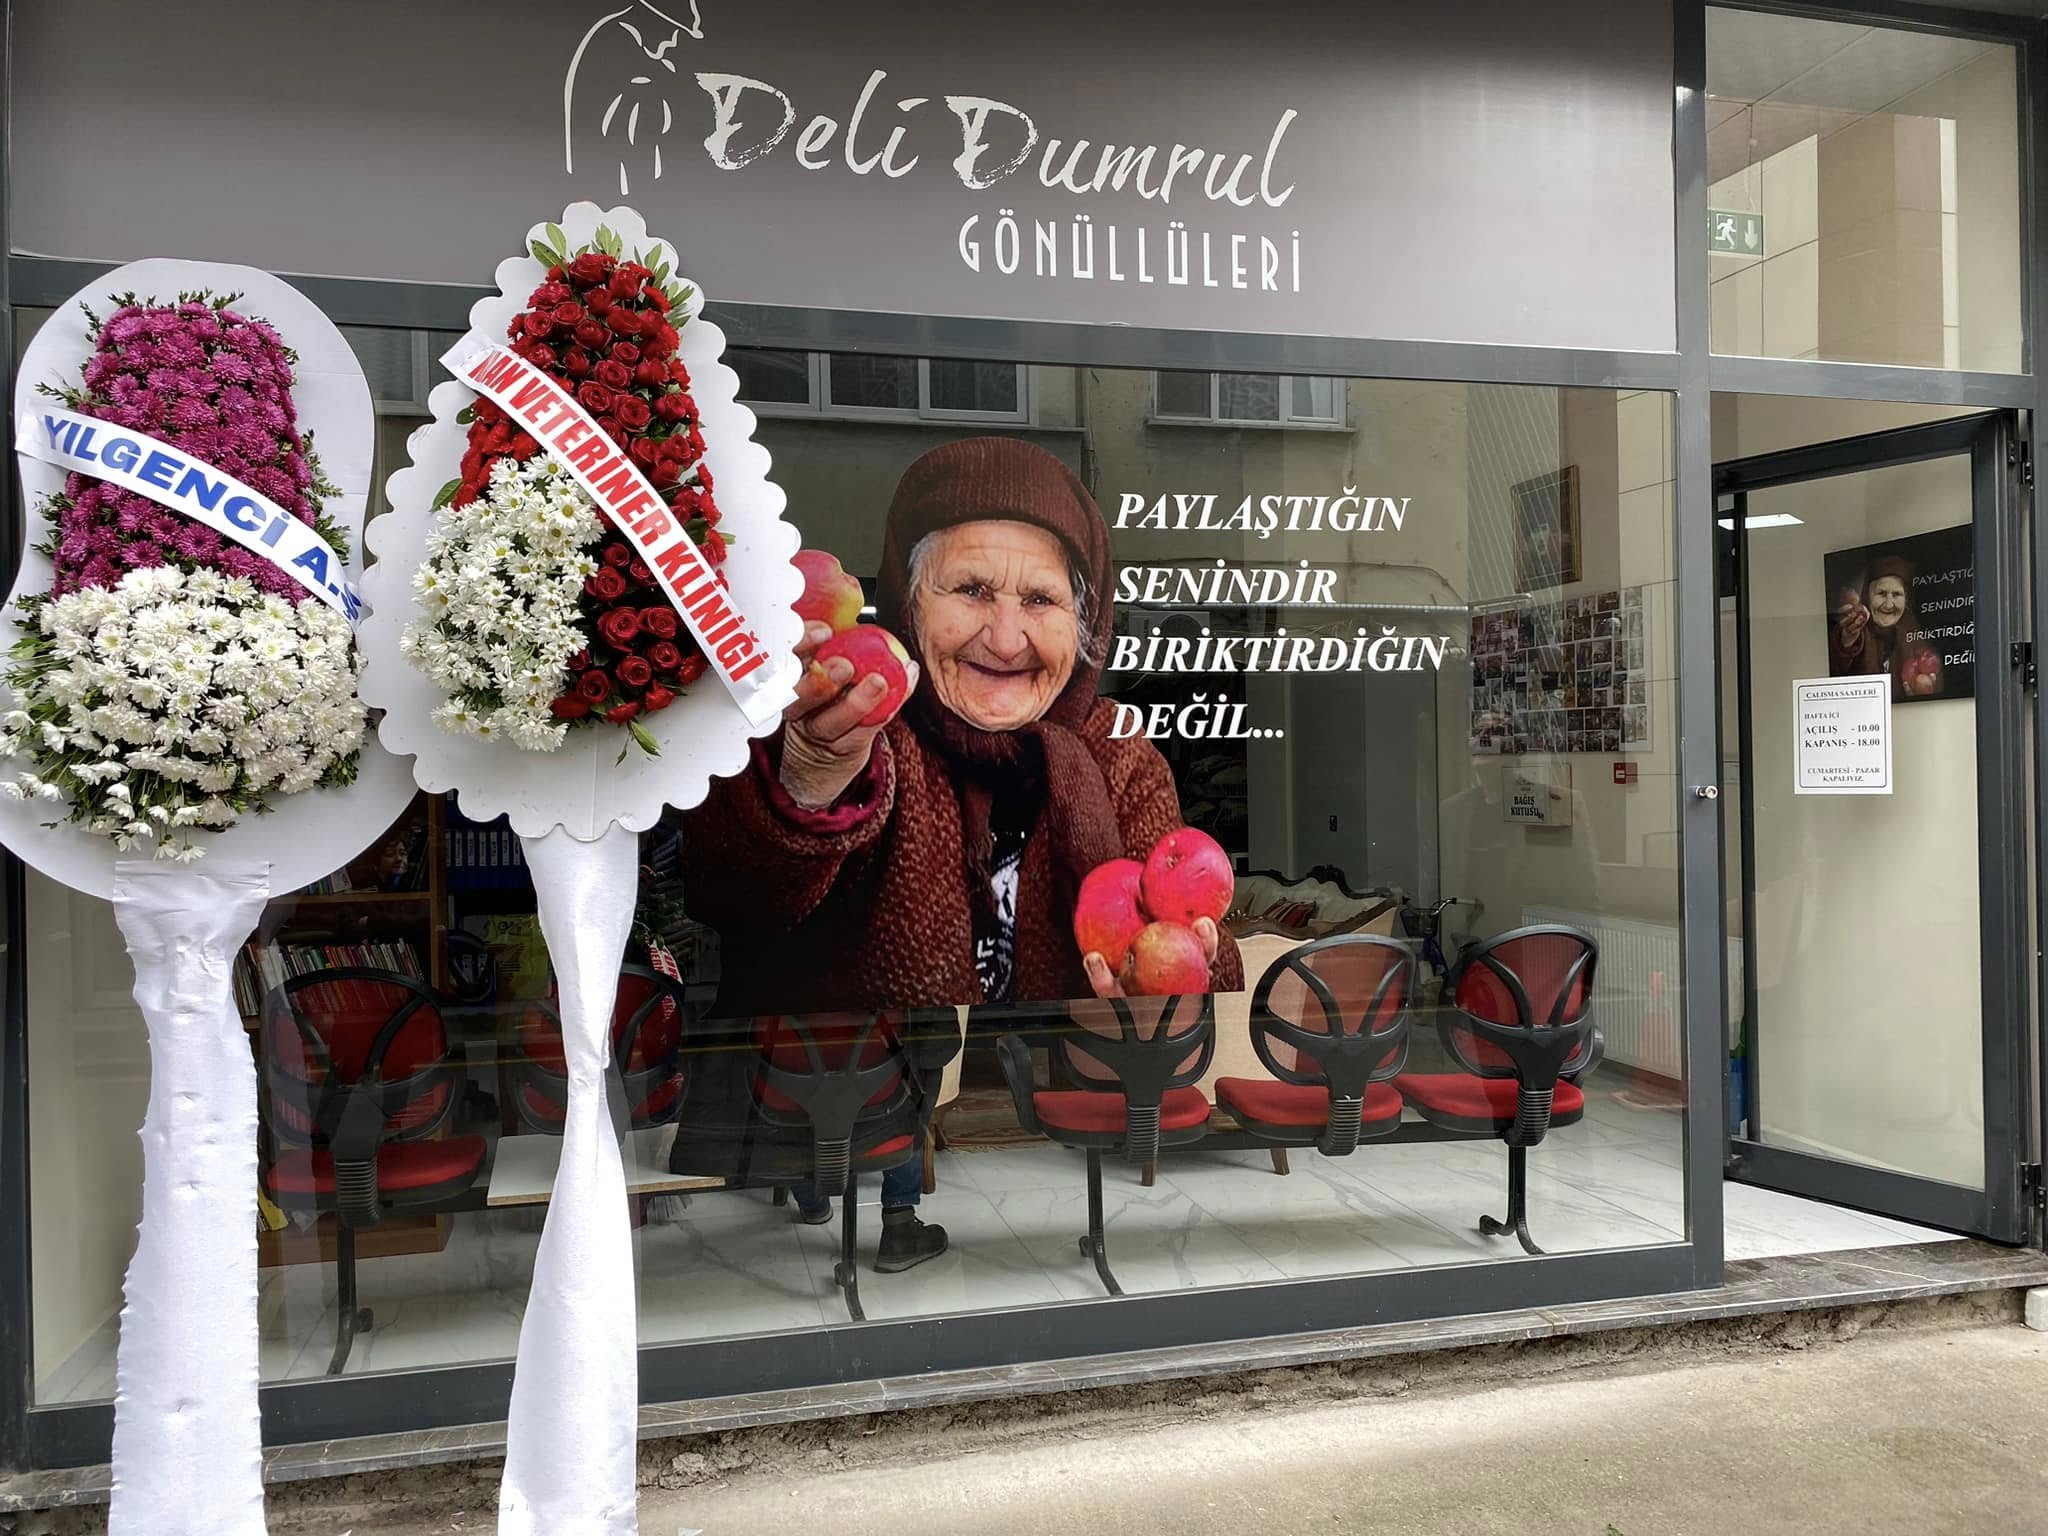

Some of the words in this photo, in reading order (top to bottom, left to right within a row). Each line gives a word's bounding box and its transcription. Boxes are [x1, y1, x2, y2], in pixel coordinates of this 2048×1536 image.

[694, 69, 929, 178] Deli
[944, 95, 1297, 207] Dumrul
[958, 208, 1300, 292] GÖNÜLLÜLERİ
[44, 414, 293, 548] YILGENCİ
[509, 376, 672, 547] VETERİNER
[654, 540, 770, 682] KLİNİĞİ
[1112, 485, 1412, 539] PAYLAŞTIĞIN
[1113, 559, 1337, 604] SENİNDİR
[1108, 626, 1450, 672] BİRİKTİRDİĞIN
[1108, 692, 1285, 739] DEĞİL...
[1805, 725, 1838, 735] AÇILIŞ
[1857, 724, 1880, 733] 10.00
[1804, 738, 1848, 748] KAPANIŞ
[1857, 738, 1881, 747] 18.00
